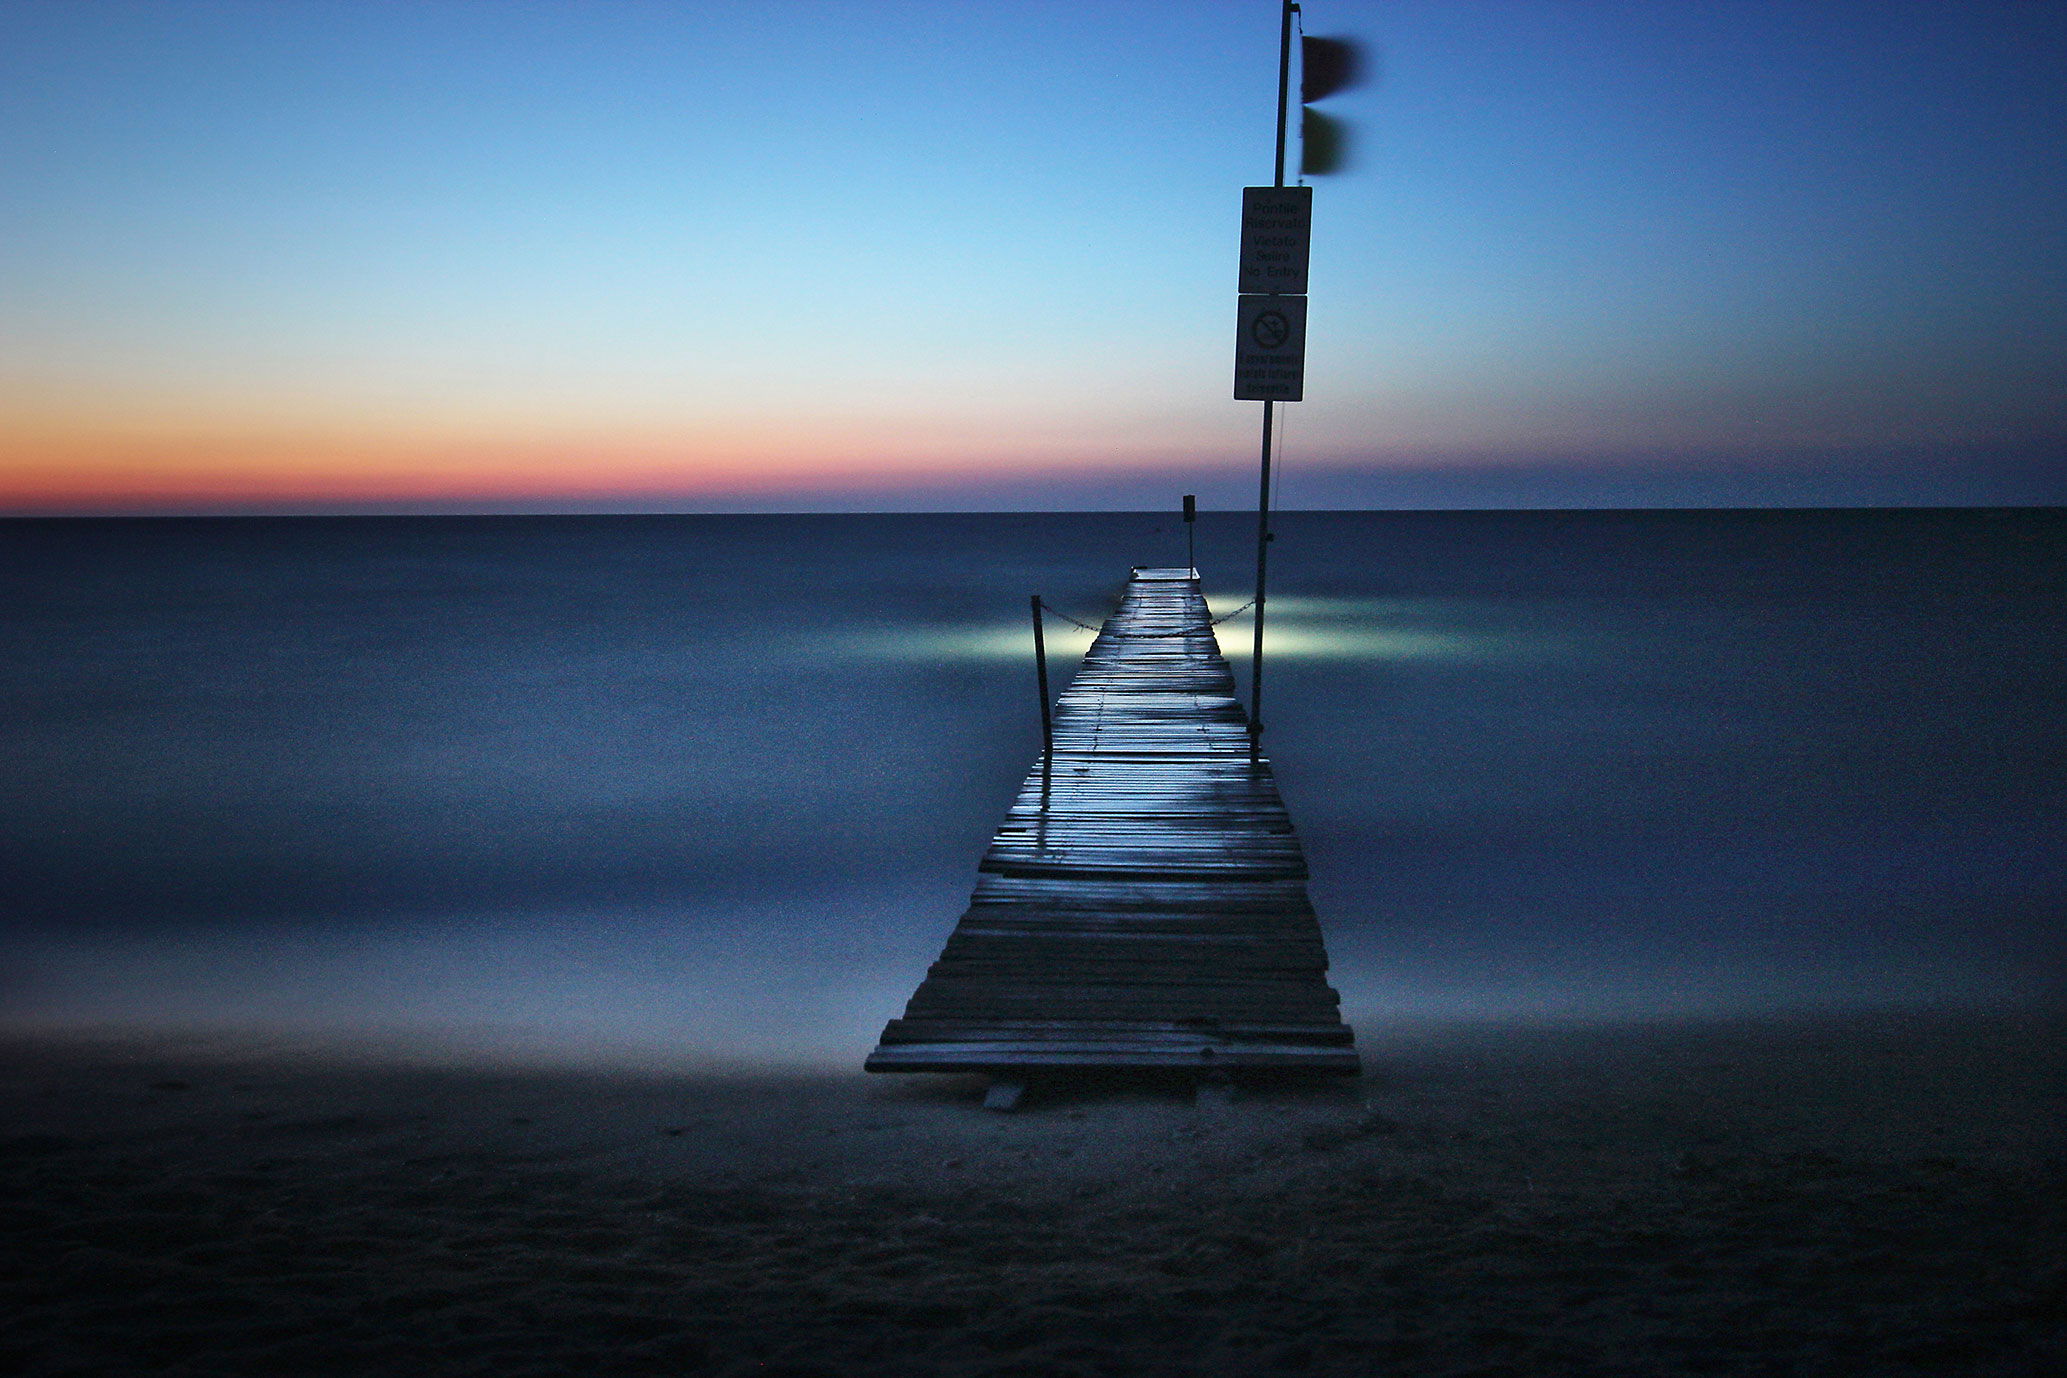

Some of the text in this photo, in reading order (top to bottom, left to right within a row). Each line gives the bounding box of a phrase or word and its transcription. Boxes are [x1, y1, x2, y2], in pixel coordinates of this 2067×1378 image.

[1253, 202, 1298, 214] Pontile
[1246, 217, 1305, 229] Riservato
[1254, 236, 1296, 247] Vietato
[1267, 266, 1301, 279] Entry
